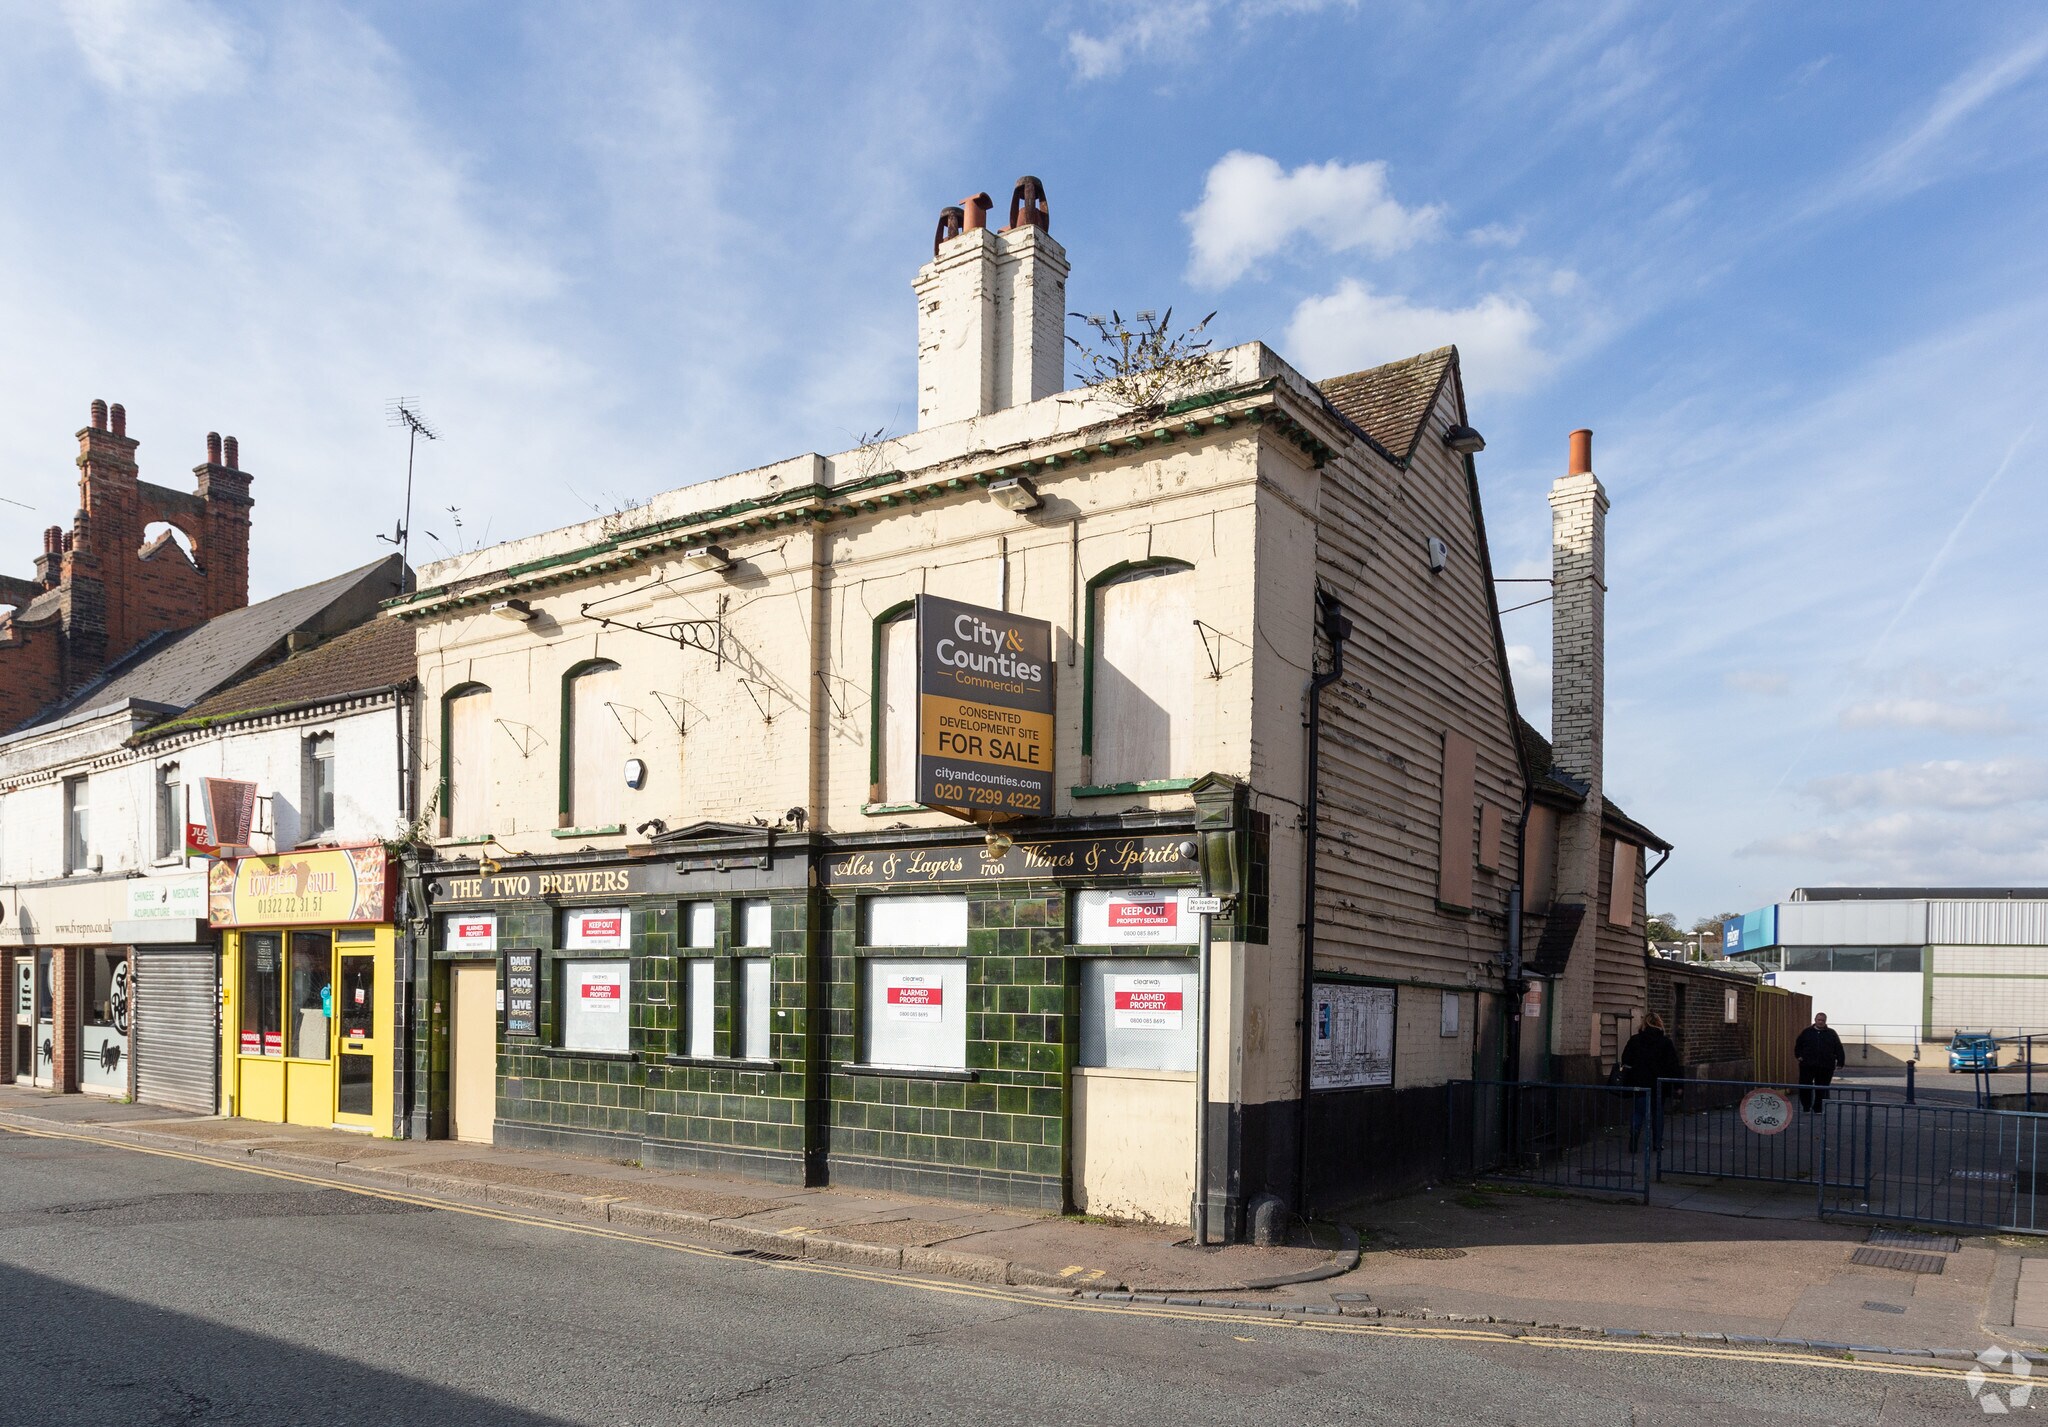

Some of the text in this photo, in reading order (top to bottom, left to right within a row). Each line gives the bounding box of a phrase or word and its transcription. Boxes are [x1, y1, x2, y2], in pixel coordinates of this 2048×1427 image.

[936, 638, 1041, 682] Counties
[955, 670, 1024, 694] Commercial
[959, 705, 1021, 725] CONSENTED
[940, 715, 1039, 740] DEVELOPMENT SITE
[939, 731, 1040, 764] FOR SALE
[935, 767, 1041, 790] cityandcounties.com
[934, 783, 1041, 810] 020 7299 4222
[191, 827, 209, 837] JUS
[196, 837, 209, 845] EA
[1021, 840, 1180, 872] Wines & Spirits
[834, 850, 963, 880] Ales & Lagers
[980, 863, 1005, 878] 1700
[248, 872, 338, 896] LOWFIELD GRILL
[449, 870, 629, 899] THE TWO BREWERS
[134, 888, 199, 901] CHINESE MEDICINE
[1128, 887, 1156, 898] clearway
[257, 896, 322, 913] 01322 22 31 51
[1199, 899, 1218, 907] loading
[1121, 906, 1164, 916] KEEP OUT
[55, 918, 113, 938] www.fvrepro.co.uk
[588, 921, 614, 929] KEEP OUT
[510, 956, 532, 966] DART
[510, 978, 533, 988] POOL
[1133, 978, 1161, 987] clearway
[900, 989, 929, 997] ALARMED
[1130, 993, 1166, 1001] ALARMED
[511, 999, 532, 1010] LIVE
[899, 996, 930, 1004] PROPERTY
[1129, 1001, 1167, 1009] PROPERTY
[1143, 1017, 1152, 1025] 085
